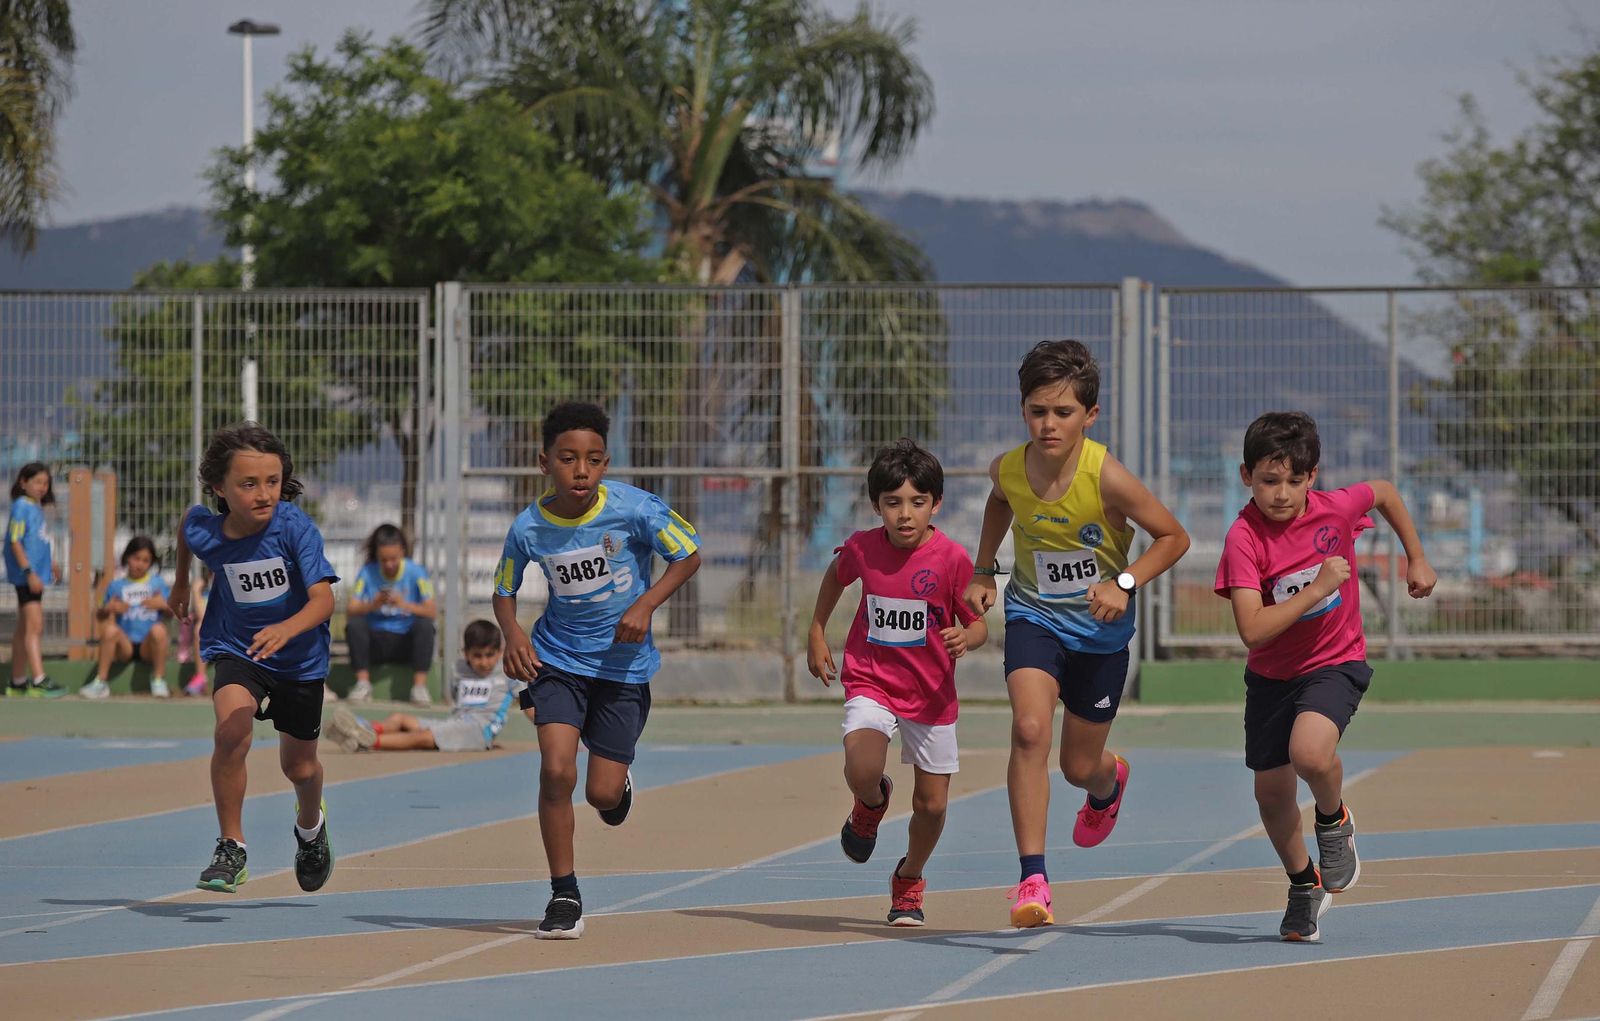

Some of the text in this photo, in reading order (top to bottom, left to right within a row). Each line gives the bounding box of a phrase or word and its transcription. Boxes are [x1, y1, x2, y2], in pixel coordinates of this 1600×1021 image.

[238, 567, 287, 592] 3418
[556, 556, 610, 585] 3482
[1046, 558, 1097, 583] 3415
[874, 607, 925, 631] 3408
